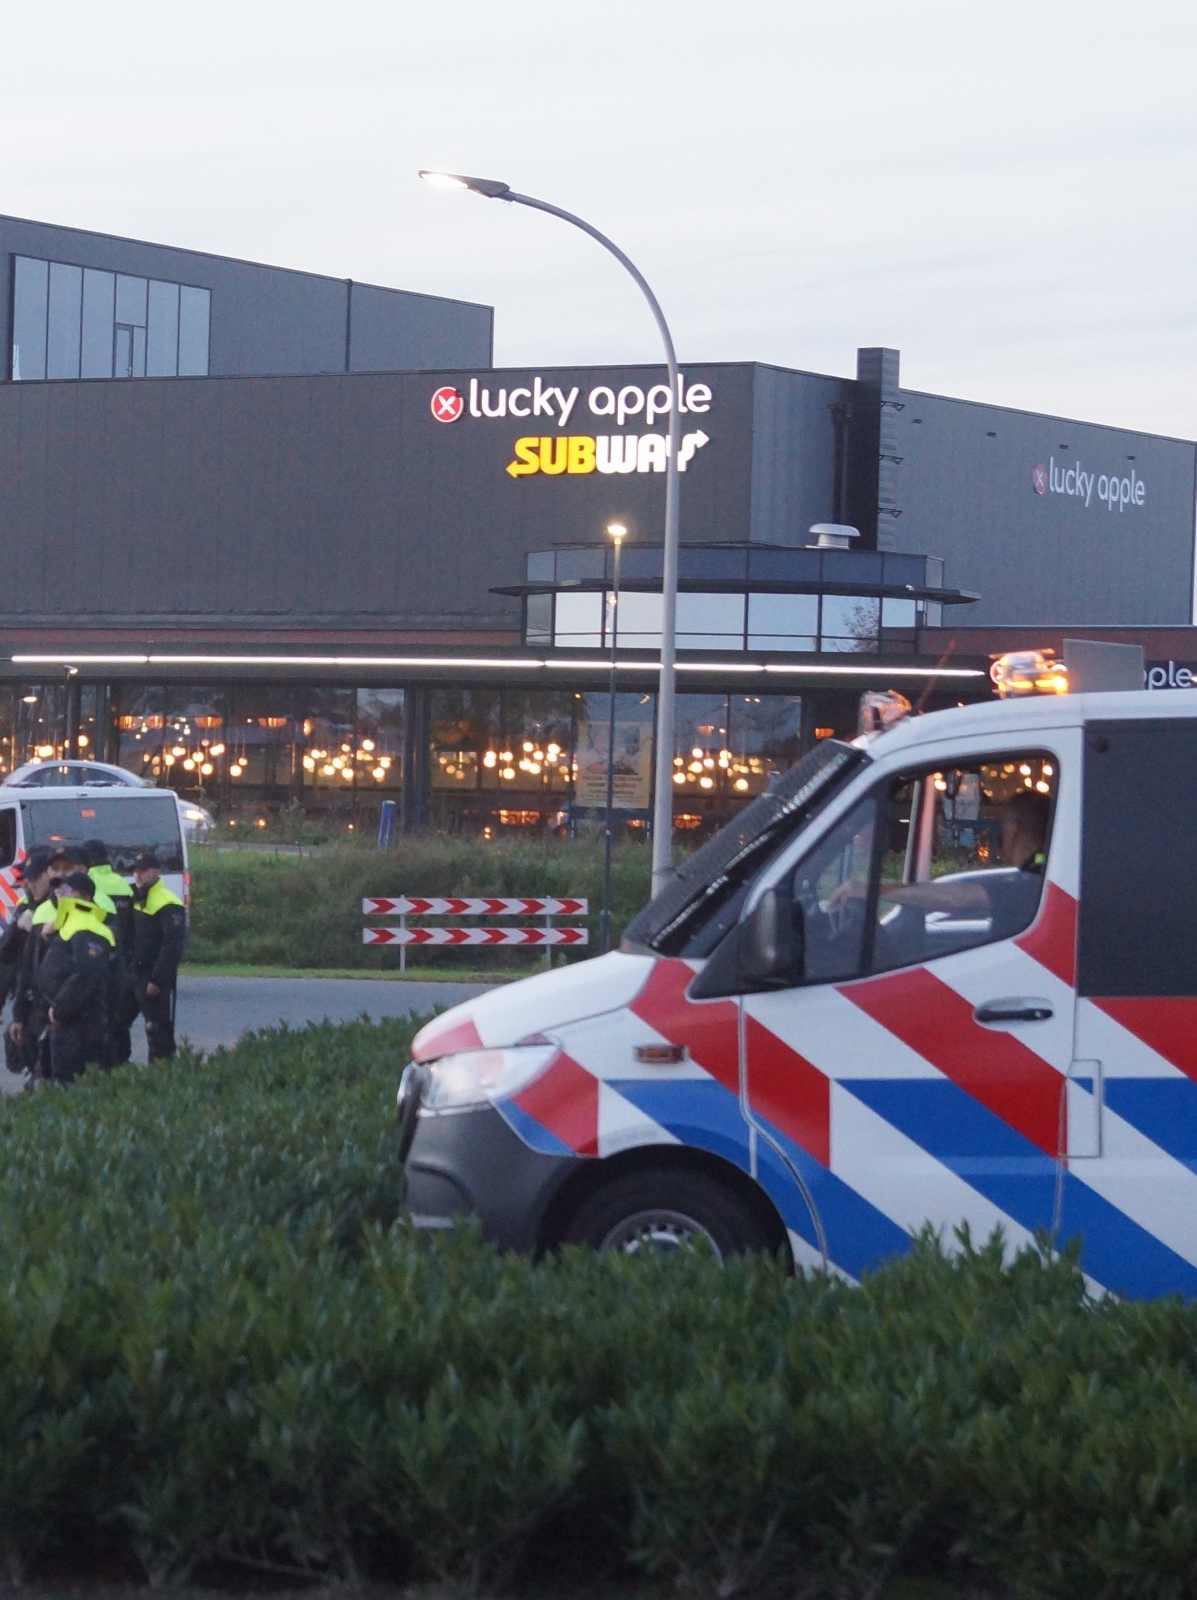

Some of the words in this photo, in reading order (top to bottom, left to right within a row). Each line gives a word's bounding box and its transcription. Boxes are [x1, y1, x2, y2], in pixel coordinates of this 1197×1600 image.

[469, 377, 579, 427] lucky
[589, 373, 712, 426] apple
[506, 430, 710, 478] SUBWAY
[1049, 456, 1095, 507] lucky
[1097, 469, 1145, 512] apple
[1143, 660, 1192, 690] ple
